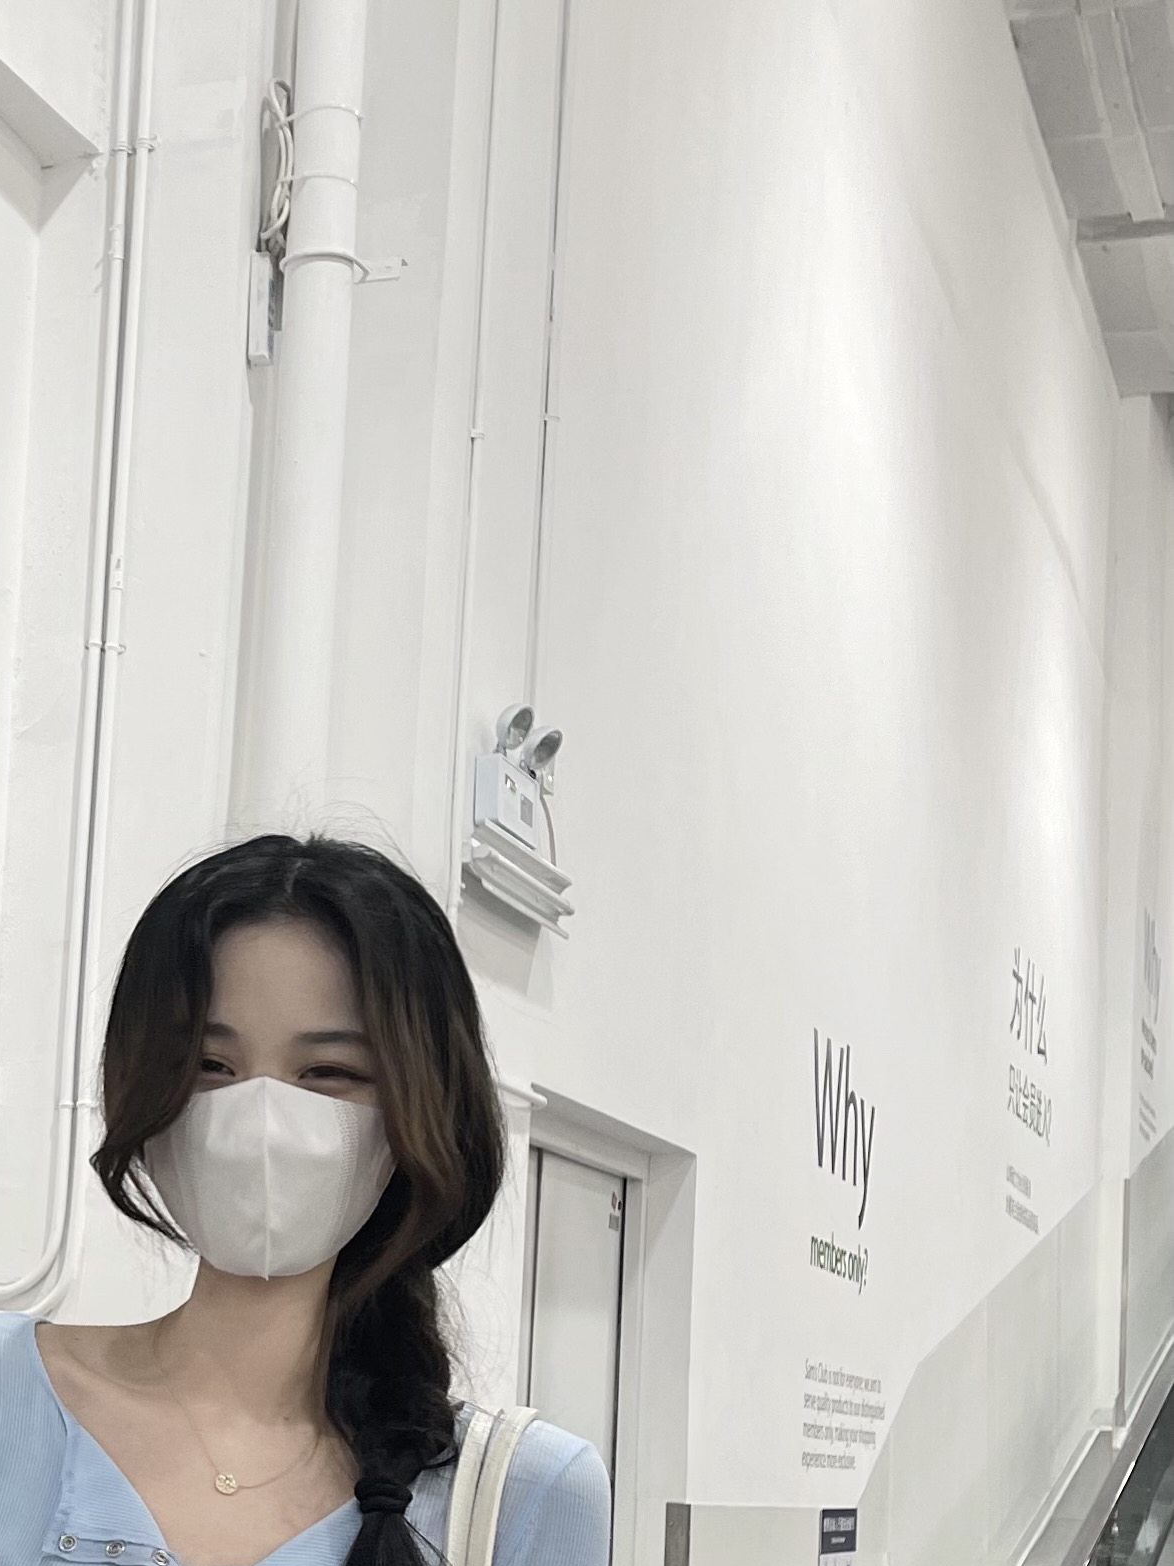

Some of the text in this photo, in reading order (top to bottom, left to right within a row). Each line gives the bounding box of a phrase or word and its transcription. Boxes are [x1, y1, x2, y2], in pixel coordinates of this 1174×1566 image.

[1010, 946, 1048, 1066] 为什么
[813, 1026, 876, 1231] Why
[809, 1231, 869, 1296] members only?
